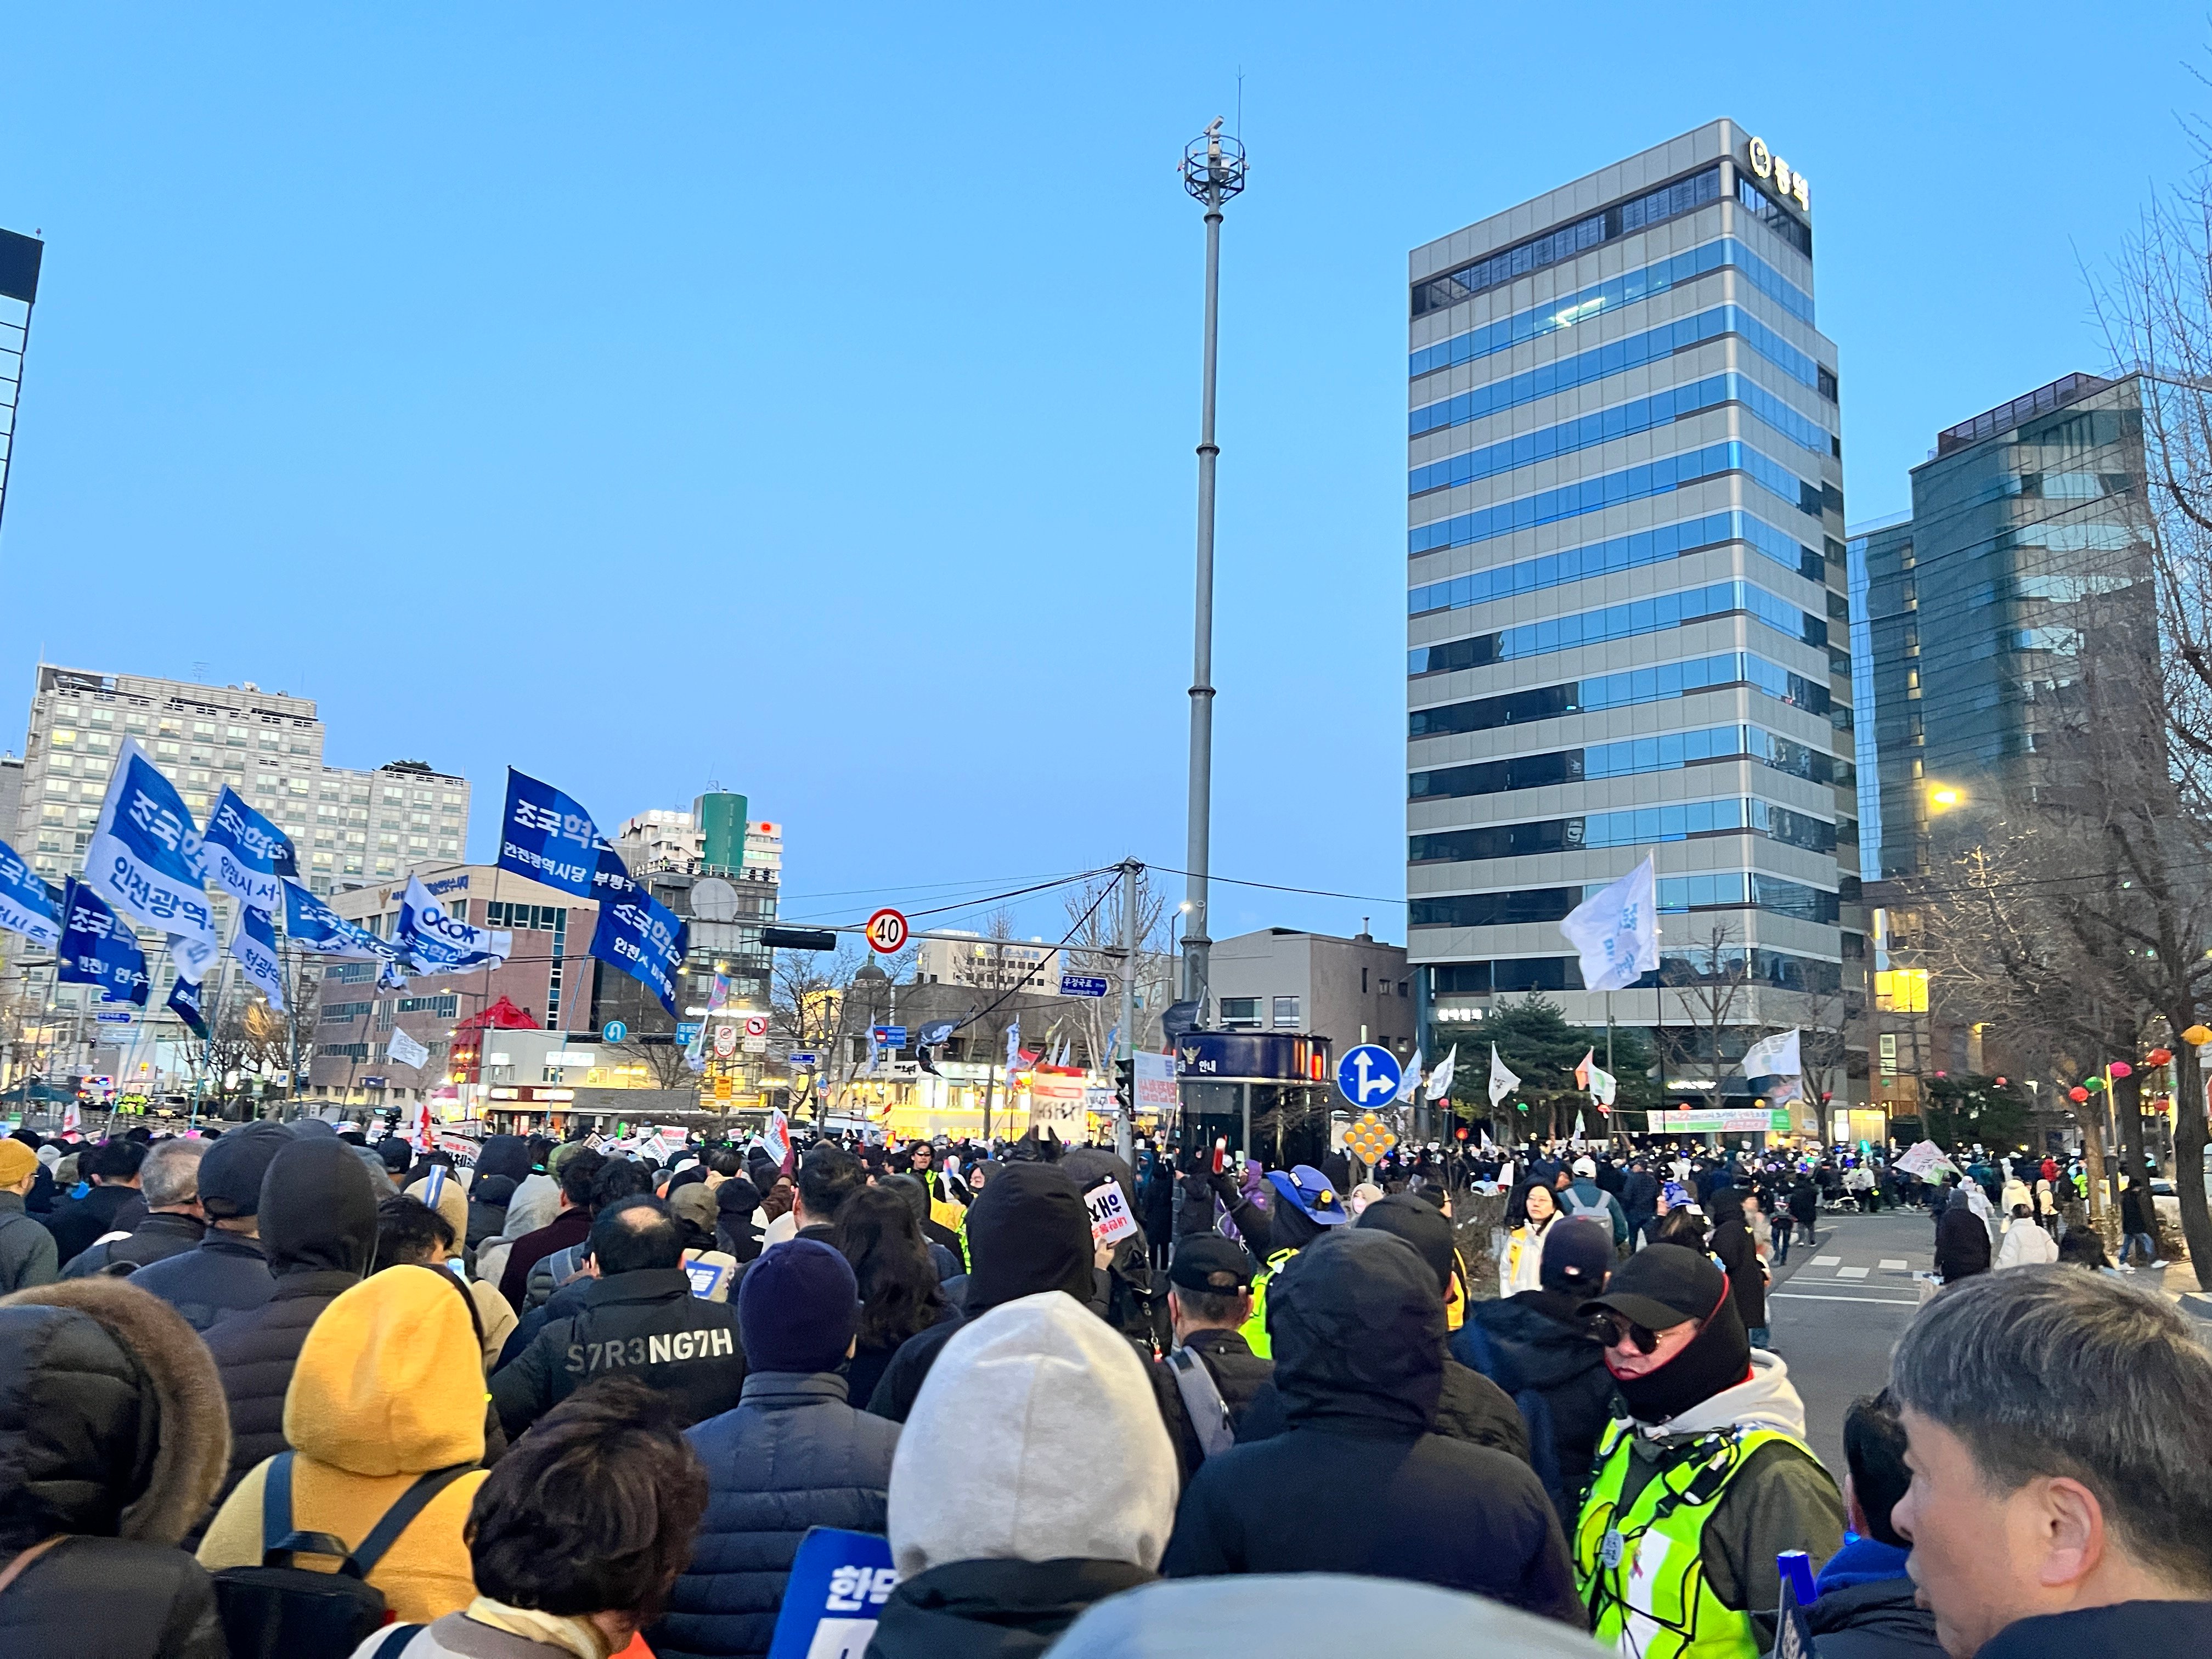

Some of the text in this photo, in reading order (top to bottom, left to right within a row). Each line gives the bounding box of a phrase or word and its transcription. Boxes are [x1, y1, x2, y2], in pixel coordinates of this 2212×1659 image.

[504, 841, 587, 883] 인천광역시당
[109, 856, 216, 930] 인천광역
[256, 884, 281, 901] 서
[875, 918, 899, 943] 40
[1063, 977, 1092, 988] 우정국로
[1199, 1060, 1216, 1073] 안내
[565, 1328, 733, 1372] S7R3NG7H
